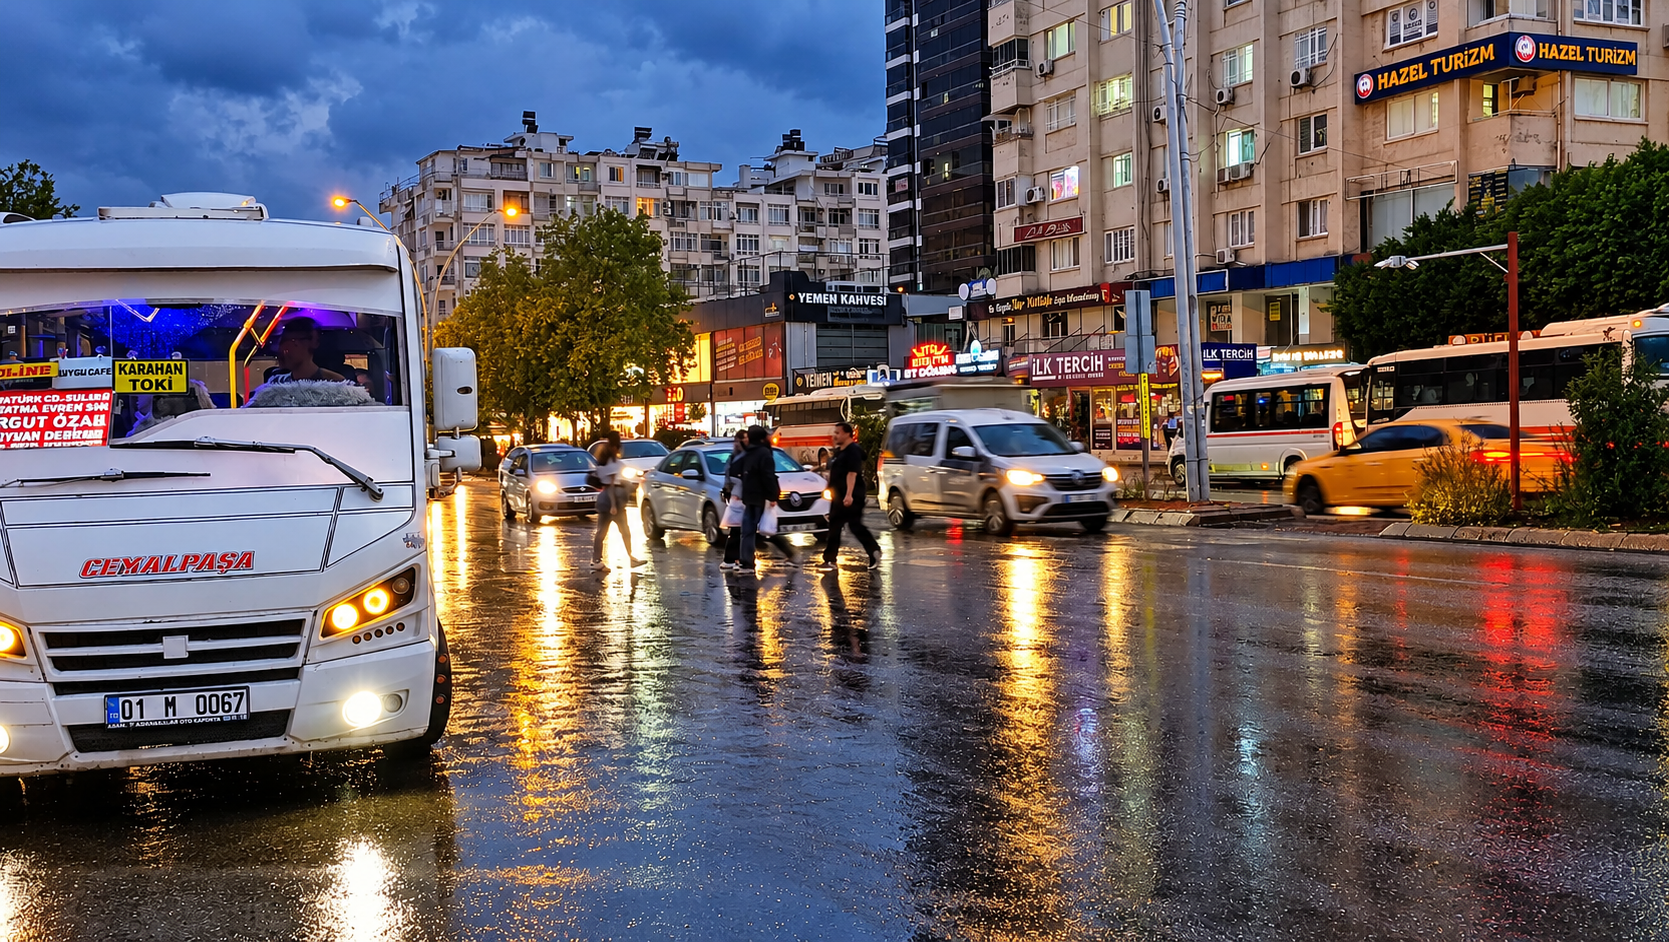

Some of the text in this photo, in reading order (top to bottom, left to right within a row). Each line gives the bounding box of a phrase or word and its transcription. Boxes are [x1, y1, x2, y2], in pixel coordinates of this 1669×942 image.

[1538, 42, 1637, 66] HAZEL TURİZM
[1377, 43, 1495, 91] HAZEL TURİZM
[797, 292, 838, 304] YEMEN
[118, 362, 183, 376] KARAHAN
[1032, 358, 1052, 376] İLK
[1056, 352, 1104, 374] TERCİH
[128, 376, 173, 391] TOKİ
[80, 551, 255, 577] CEMALPAŞA
[121, 691, 245, 720] 01 M 0067
